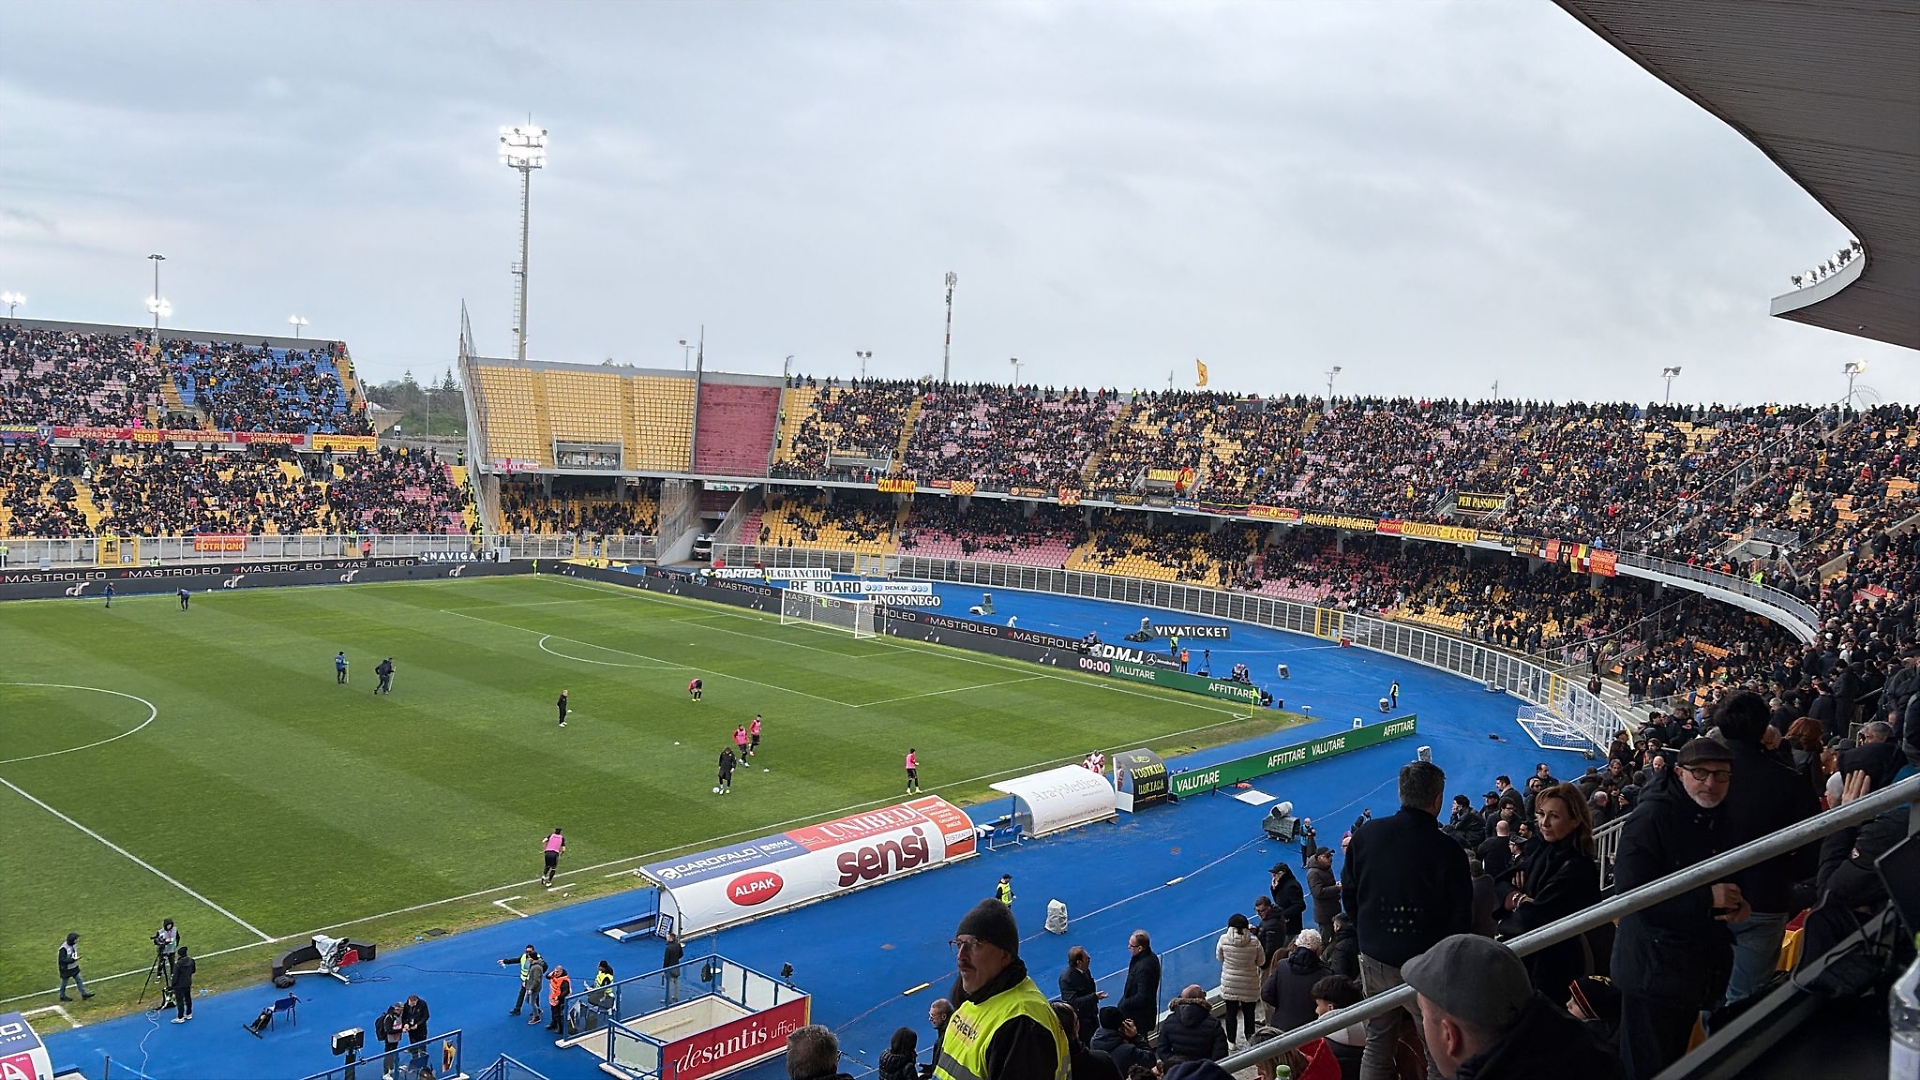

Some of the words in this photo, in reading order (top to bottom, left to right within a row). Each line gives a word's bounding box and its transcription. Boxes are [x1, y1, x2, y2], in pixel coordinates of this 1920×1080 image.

[877, 479, 916, 493] ZOLLINO
[1403, 523, 1442, 536] OVUNQUE
[5, 571, 107, 583] MASTROLEO
[129, 566, 221, 579] MASTROLEO
[777, 568, 831, 579] GRANCHIO
[718, 581, 772, 596] MASTROLEO
[814, 581, 862, 593] BOARD
[868, 595, 896, 606] LINO
[897, 596, 941, 607] SONEGO
[929, 616, 998, 636] MASTROLEO
[1154, 625, 1228, 638] VIVATICKET
[1013, 631, 1080, 651] MASTROLE
[1079, 657, 1111, 673] 00:00
[1114, 664, 1156, 680] VALUTARE
[1208, 682, 1254, 698] AFFITTARE
[1382, 719, 1415, 737] AFFITTARE
[1311, 737, 1346, 756] VALUTARE
[1267, 747, 1306, 768] AFFITTARE
[1176, 770, 1220, 792] VALUTARE
[819, 807, 916, 838] UNIBED
[836, 826, 930, 888] sensi
[734, 877, 776, 898] ALPAK
[770, 1018, 797, 1039] uffici
